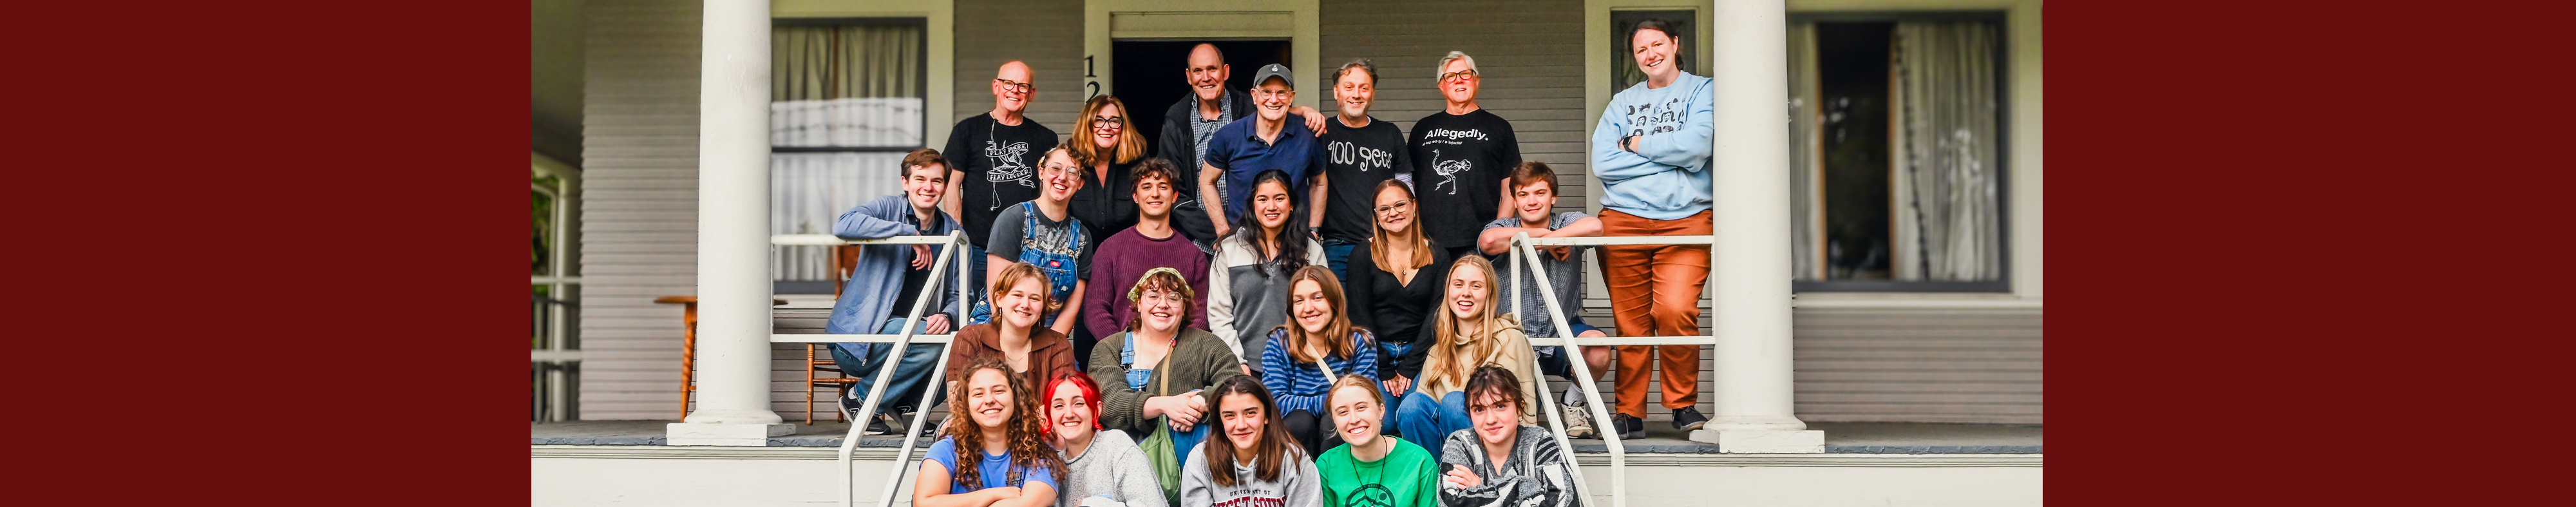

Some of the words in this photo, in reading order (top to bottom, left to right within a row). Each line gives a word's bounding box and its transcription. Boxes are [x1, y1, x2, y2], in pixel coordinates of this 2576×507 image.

[1424, 128, 1488, 141] Allegedly.
[1007, 144, 1027, 153] MORE
[1328, 140, 1355, 165] 100
[1359, 146, 1392, 172] gecs
[1006, 169, 1029, 180] LOUDER
[1254, 496, 1287, 507] SOUN
